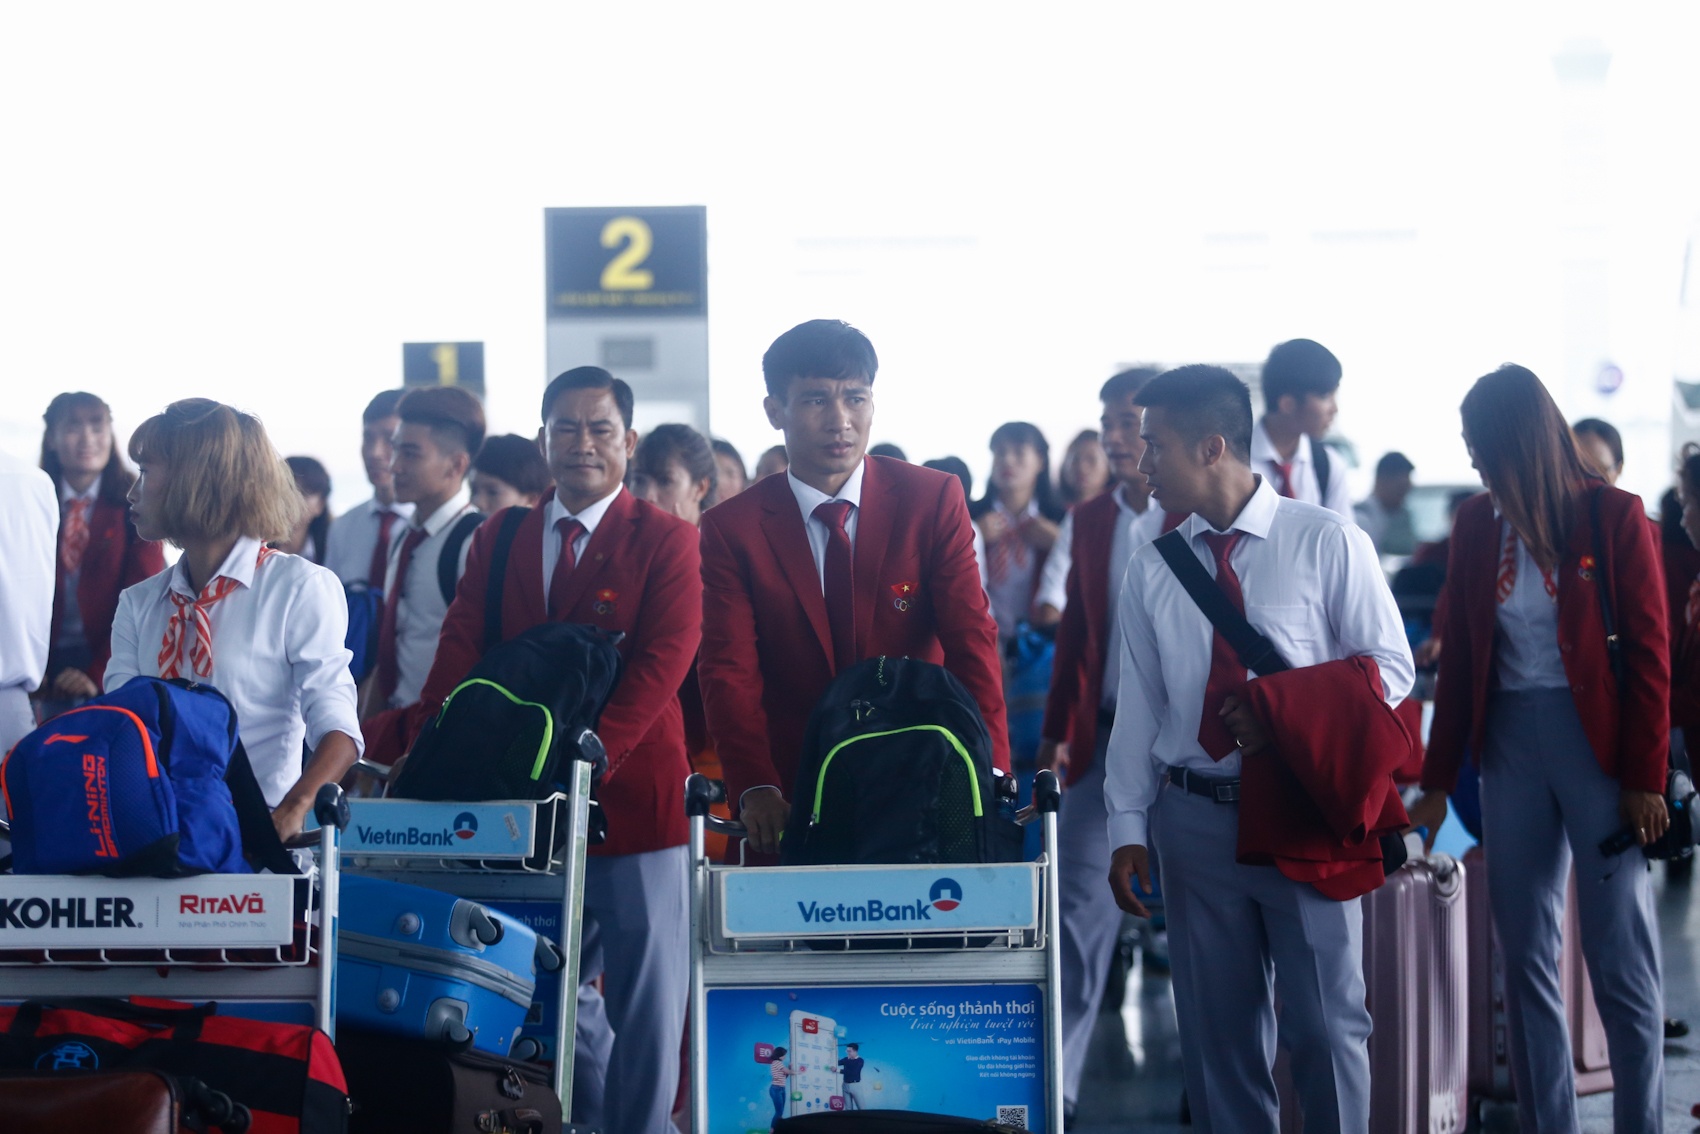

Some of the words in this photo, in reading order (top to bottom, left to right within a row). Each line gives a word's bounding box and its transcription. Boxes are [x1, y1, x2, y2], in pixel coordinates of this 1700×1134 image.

[601, 216, 654, 290] 2
[431, 344, 458, 386] 1
[357, 825, 454, 846] VietinBank
[0, 897, 137, 929] KOHLER
[797, 898, 931, 923] VietinBank
[880, 1002, 916, 1018] Cuộc
[919, 1001, 955, 1018] sống
[959, 1001, 1002, 1015] thảnh
[1006, 1000, 1035, 1014] thơi
[956, 1037, 994, 1045] VietinBank
[1012, 1036, 1035, 1044] Mobile
